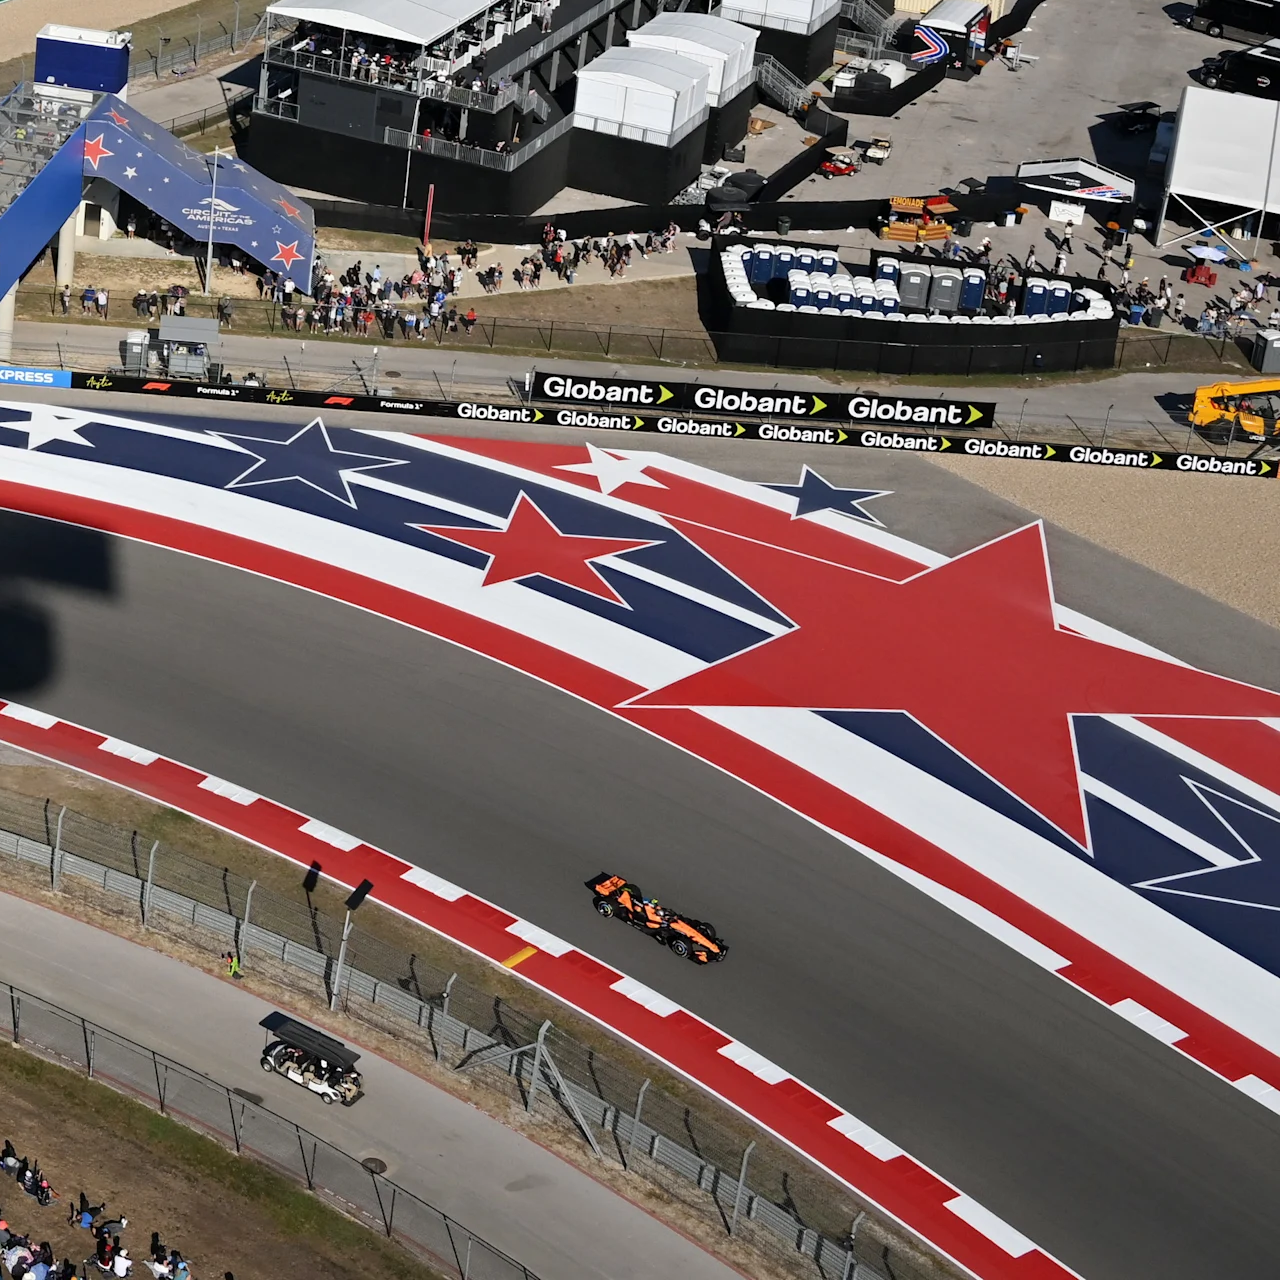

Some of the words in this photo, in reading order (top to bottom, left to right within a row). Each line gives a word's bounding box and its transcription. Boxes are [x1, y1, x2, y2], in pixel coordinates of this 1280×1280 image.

[889, 195, 925, 207] LEMONADE
[186, 212, 253, 225] AMERICAS
[197, 386, 229, 396] Formula
[543, 377, 653, 404] Globant
[380, 400, 412, 409] Formula
[695, 388, 806, 414] Globant
[848, 397, 962, 423] Globant
[458, 401, 530, 421] Globant
[557, 410, 631, 429] Globant
[658, 417, 732, 436] Globant
[759, 424, 834, 443] Globant
[861, 431, 937, 450] Globant
[965, 439, 1042, 458] Globant
[1070, 447, 1148, 466] Globant
[1177, 453, 1256, 474] Globant
